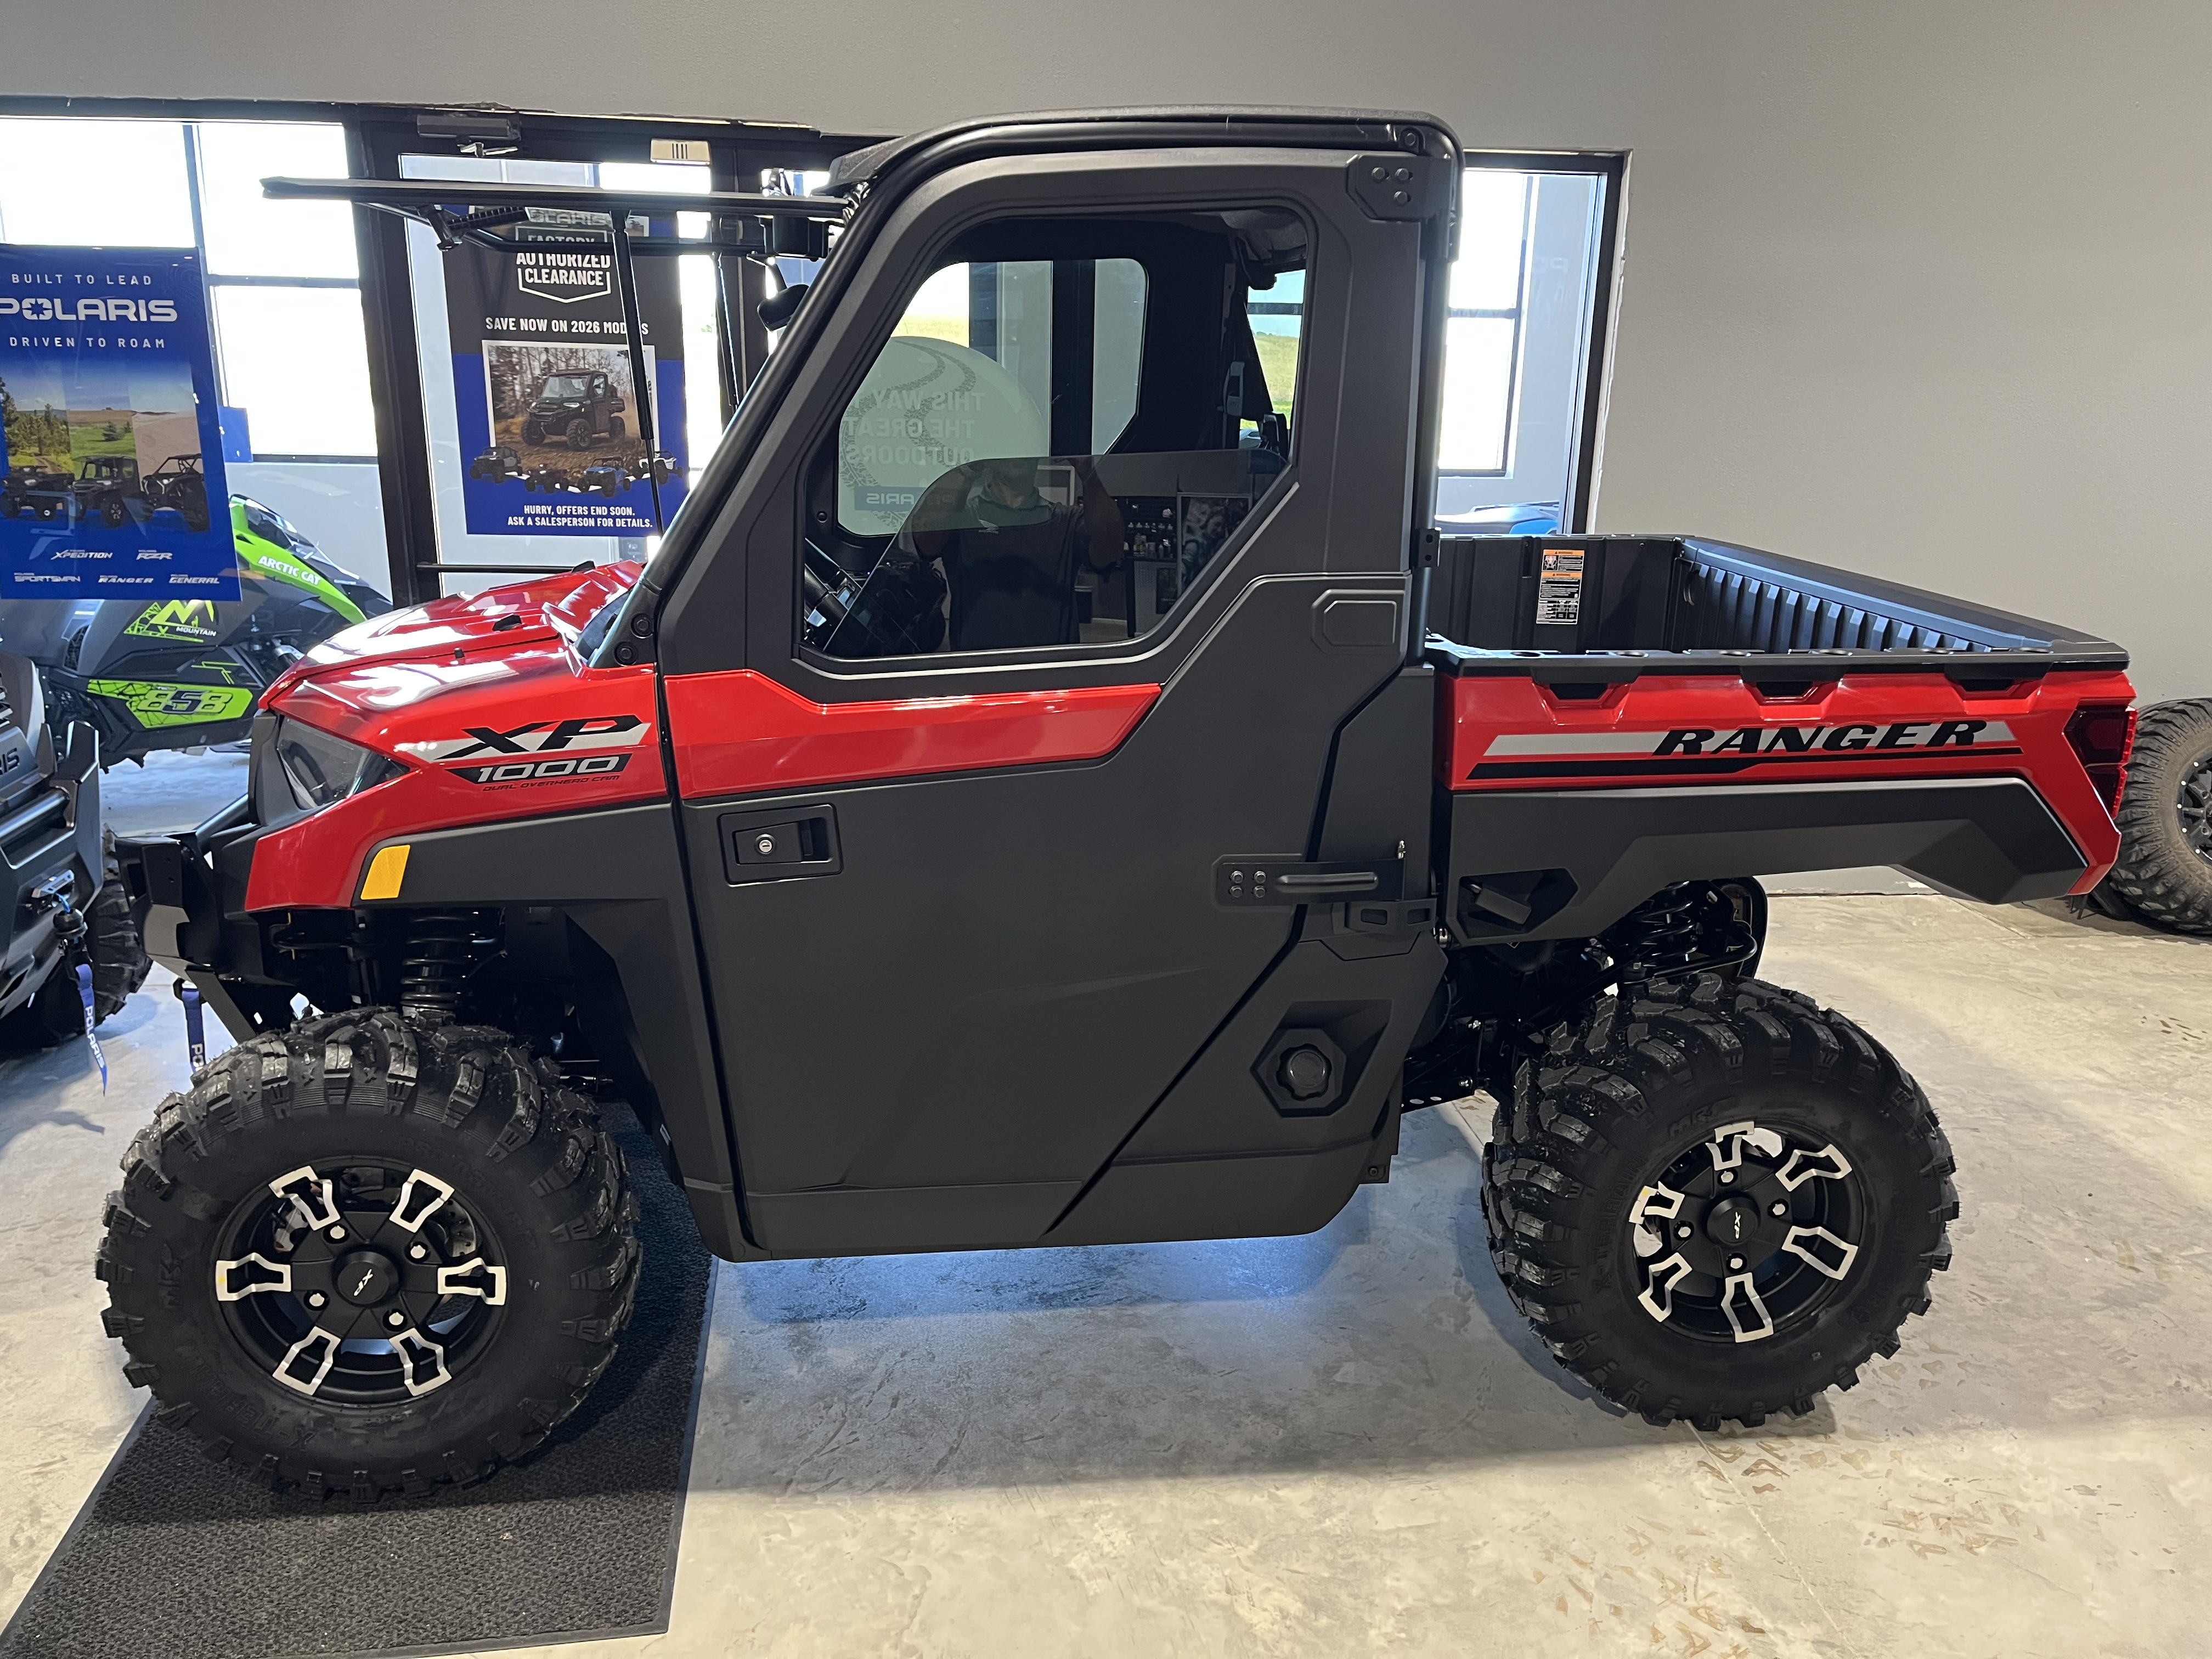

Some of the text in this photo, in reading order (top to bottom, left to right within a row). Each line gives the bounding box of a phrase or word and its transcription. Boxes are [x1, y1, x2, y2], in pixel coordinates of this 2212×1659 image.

[12, 274, 151, 285] BUILT TO LEAD
[524, 268, 605, 286] CLEARANCE
[0, 298, 178, 322] POLARIS
[485, 317, 648, 335] SAVE NOW ON 2026 MODS
[9, 337, 165, 348] DRIVEN TO ROAM
[524, 505, 635, 516] HURRY, OFFERS END SOON.
[507, 516, 653, 528] ASK A SALESPERSON FOR DETAILS.
[50, 549, 113, 560] XPEDITION
[258, 555, 321, 585] ARCTIC CAT
[176, 626, 217, 637] MOUNTAIN
[137, 689, 233, 715] 858
[434, 714, 642, 760] XP
[1652, 719, 1987, 756] RANGER
[477, 755, 620, 782] 1000
[520, 777, 590, 788] OVERHEAD
[84, 1005, 106, 1069] POLARIS
